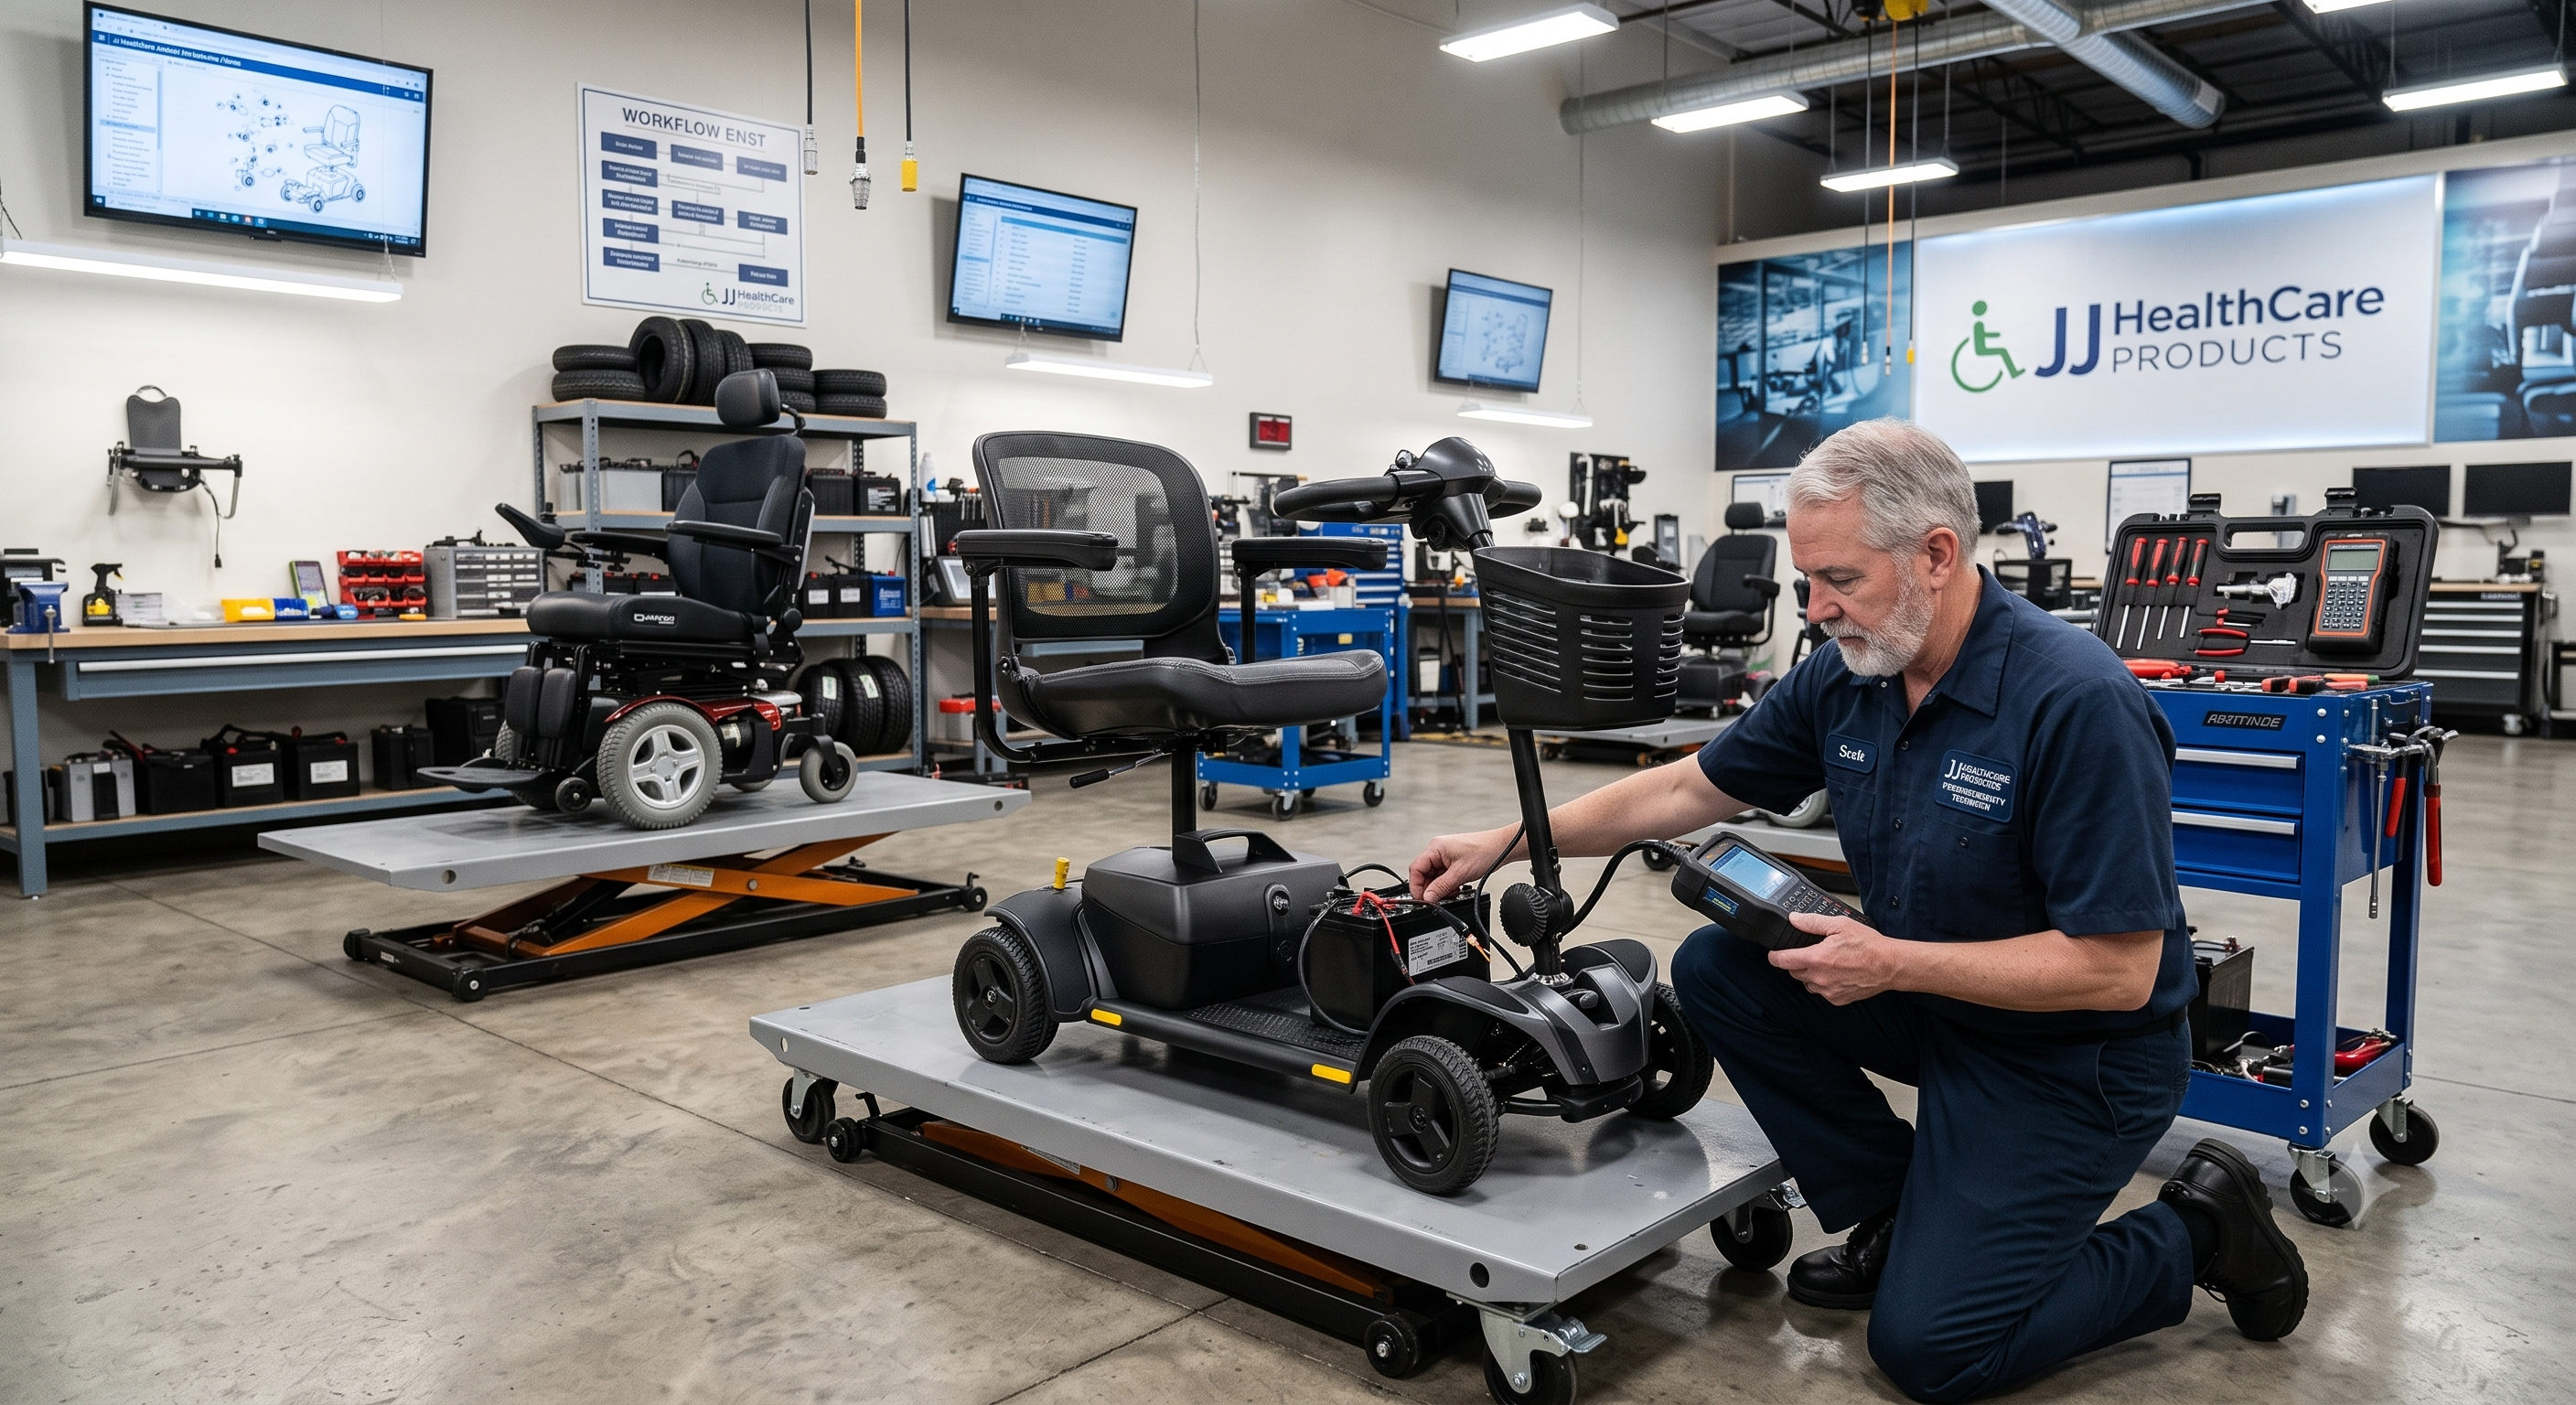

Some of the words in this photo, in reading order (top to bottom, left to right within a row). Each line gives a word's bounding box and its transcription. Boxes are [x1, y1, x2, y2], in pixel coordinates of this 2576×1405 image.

[622, 107, 721, 139] WORKFLOW
[725, 127, 767, 147] ENST
[722, 288, 735, 306] JJ
[737, 290, 795, 306] HealthCare
[2034, 304, 2101, 378] JJ
[2113, 285, 2386, 336] HealthCare
[2112, 330, 2343, 373] PRODUCTS
[1944, 758, 1963, 780] JJ
